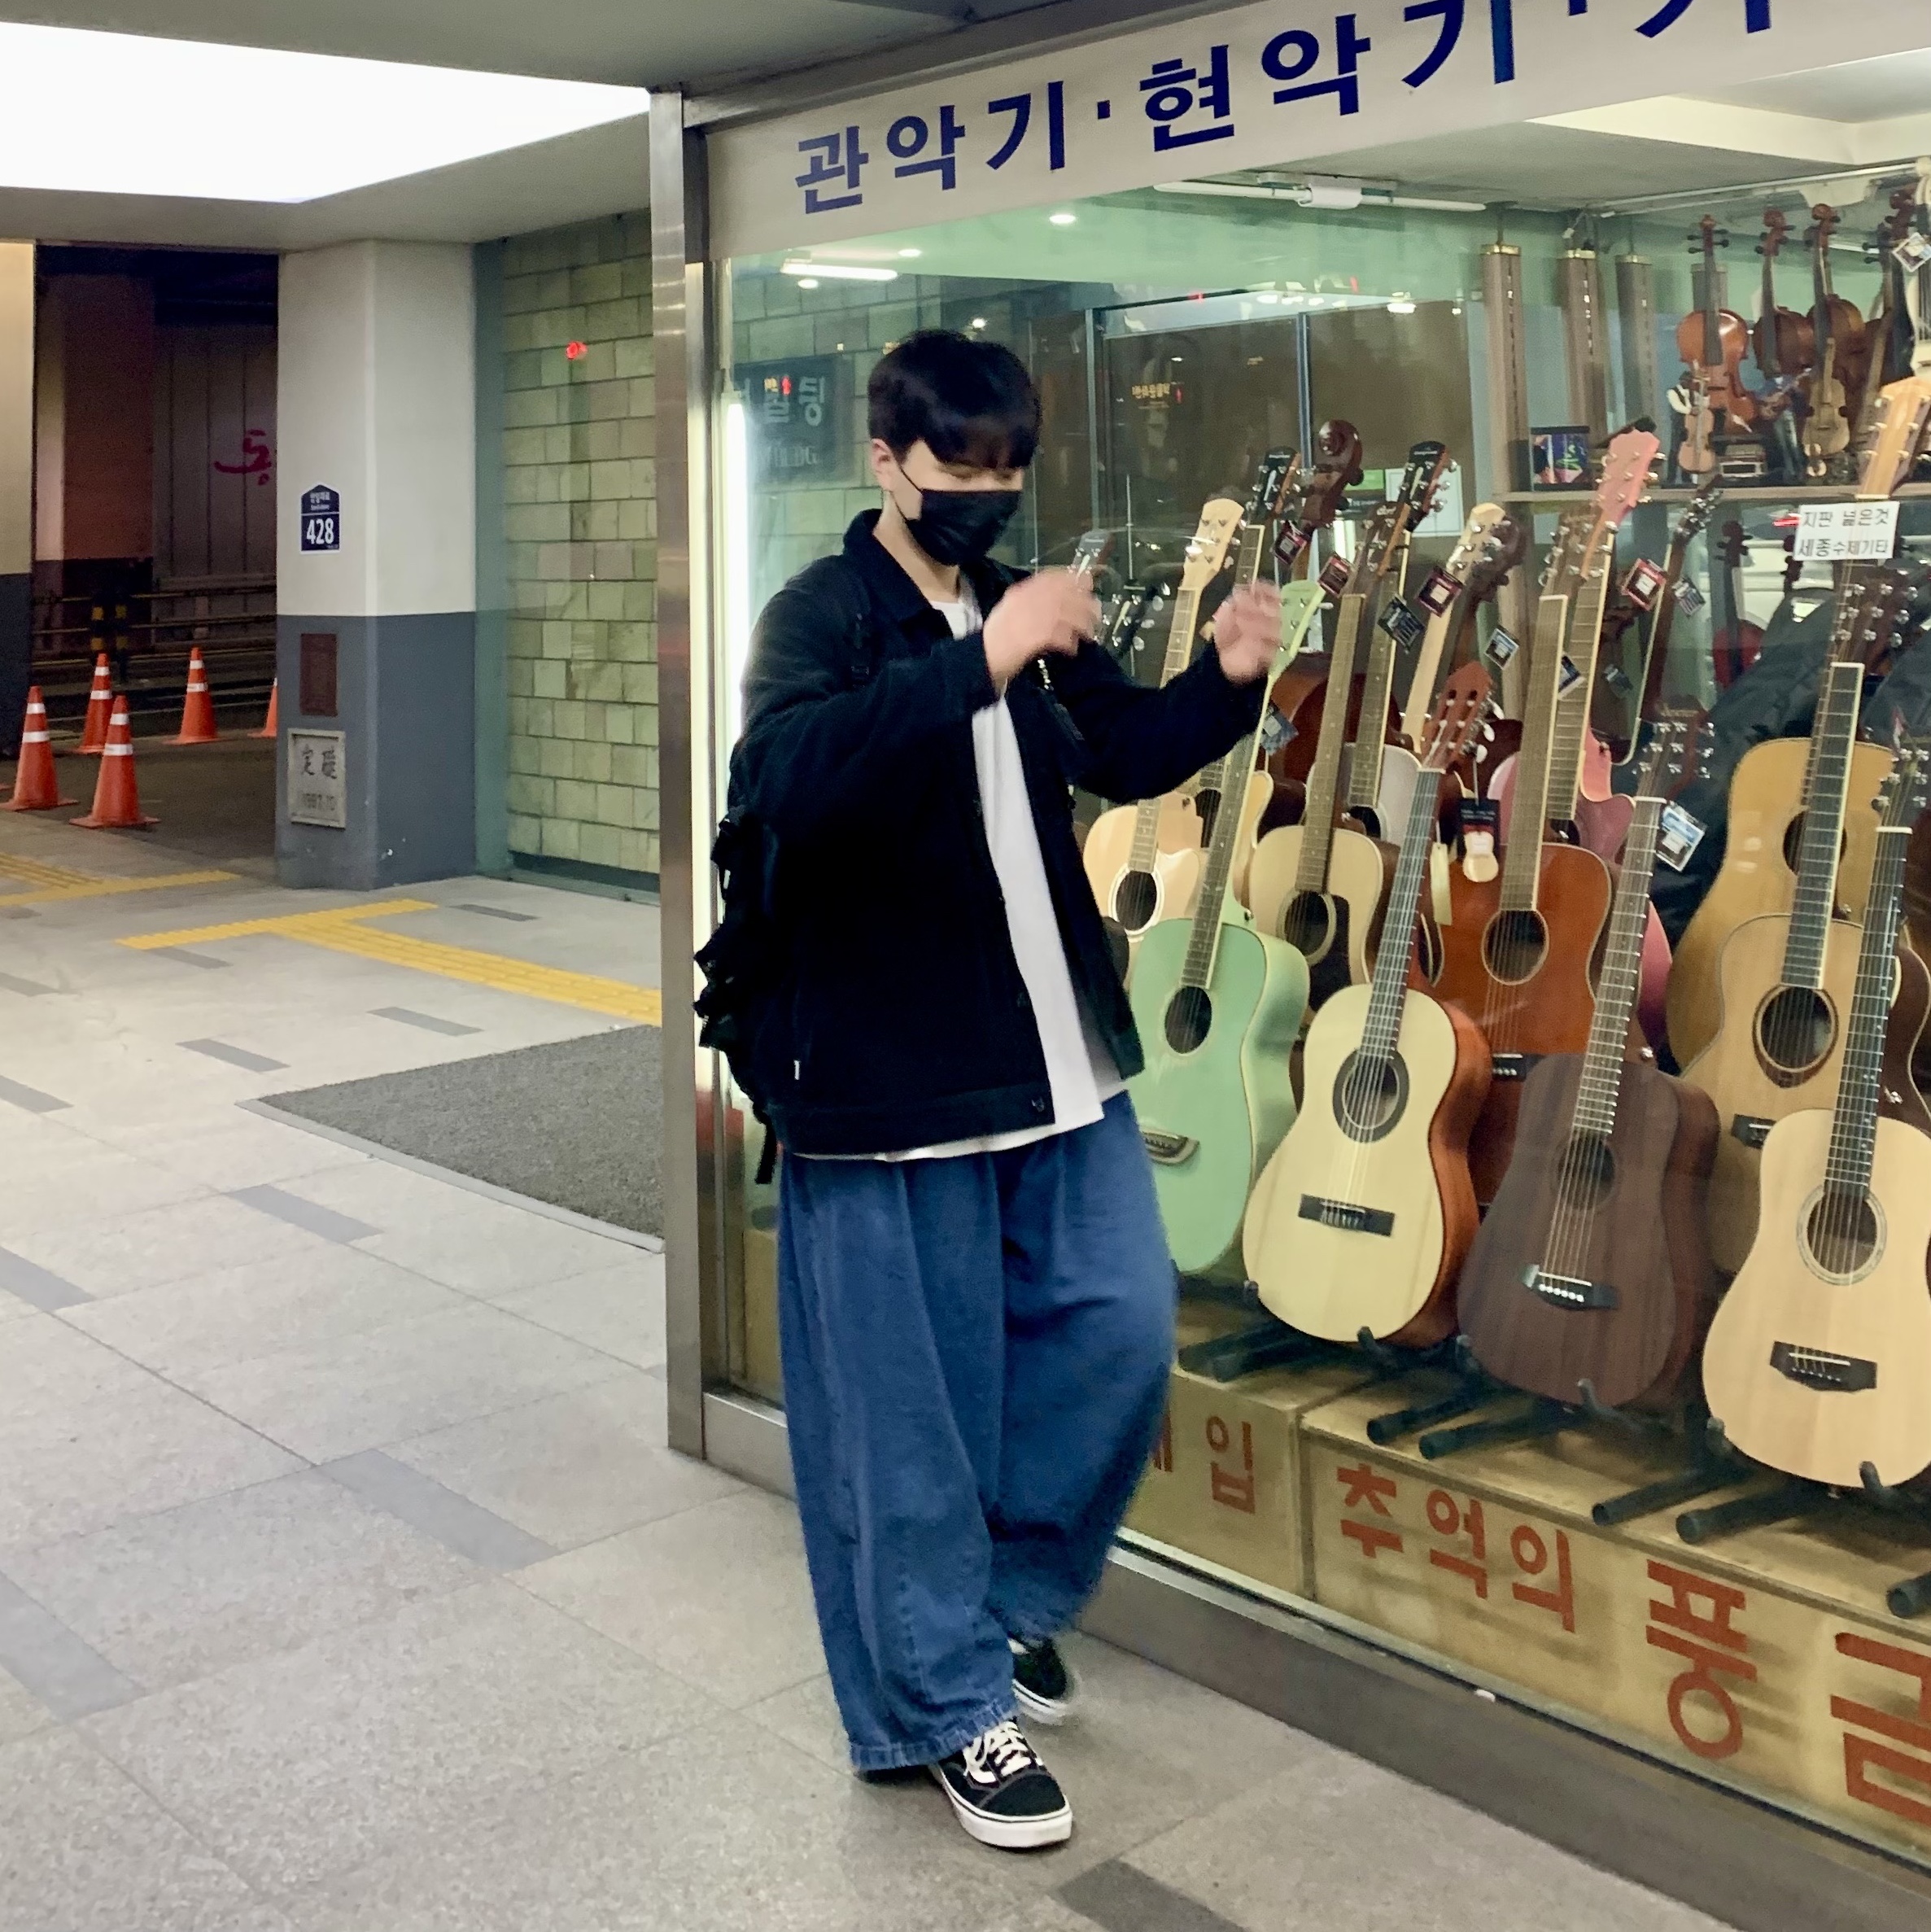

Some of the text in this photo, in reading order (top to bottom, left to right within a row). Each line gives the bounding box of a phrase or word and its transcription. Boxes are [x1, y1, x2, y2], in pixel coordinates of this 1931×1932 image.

[306, 518, 334, 544] 428
[1803, 511, 1833, 528] 지판
[1336, 1462, 1931, 1829] 추억의 풍금
